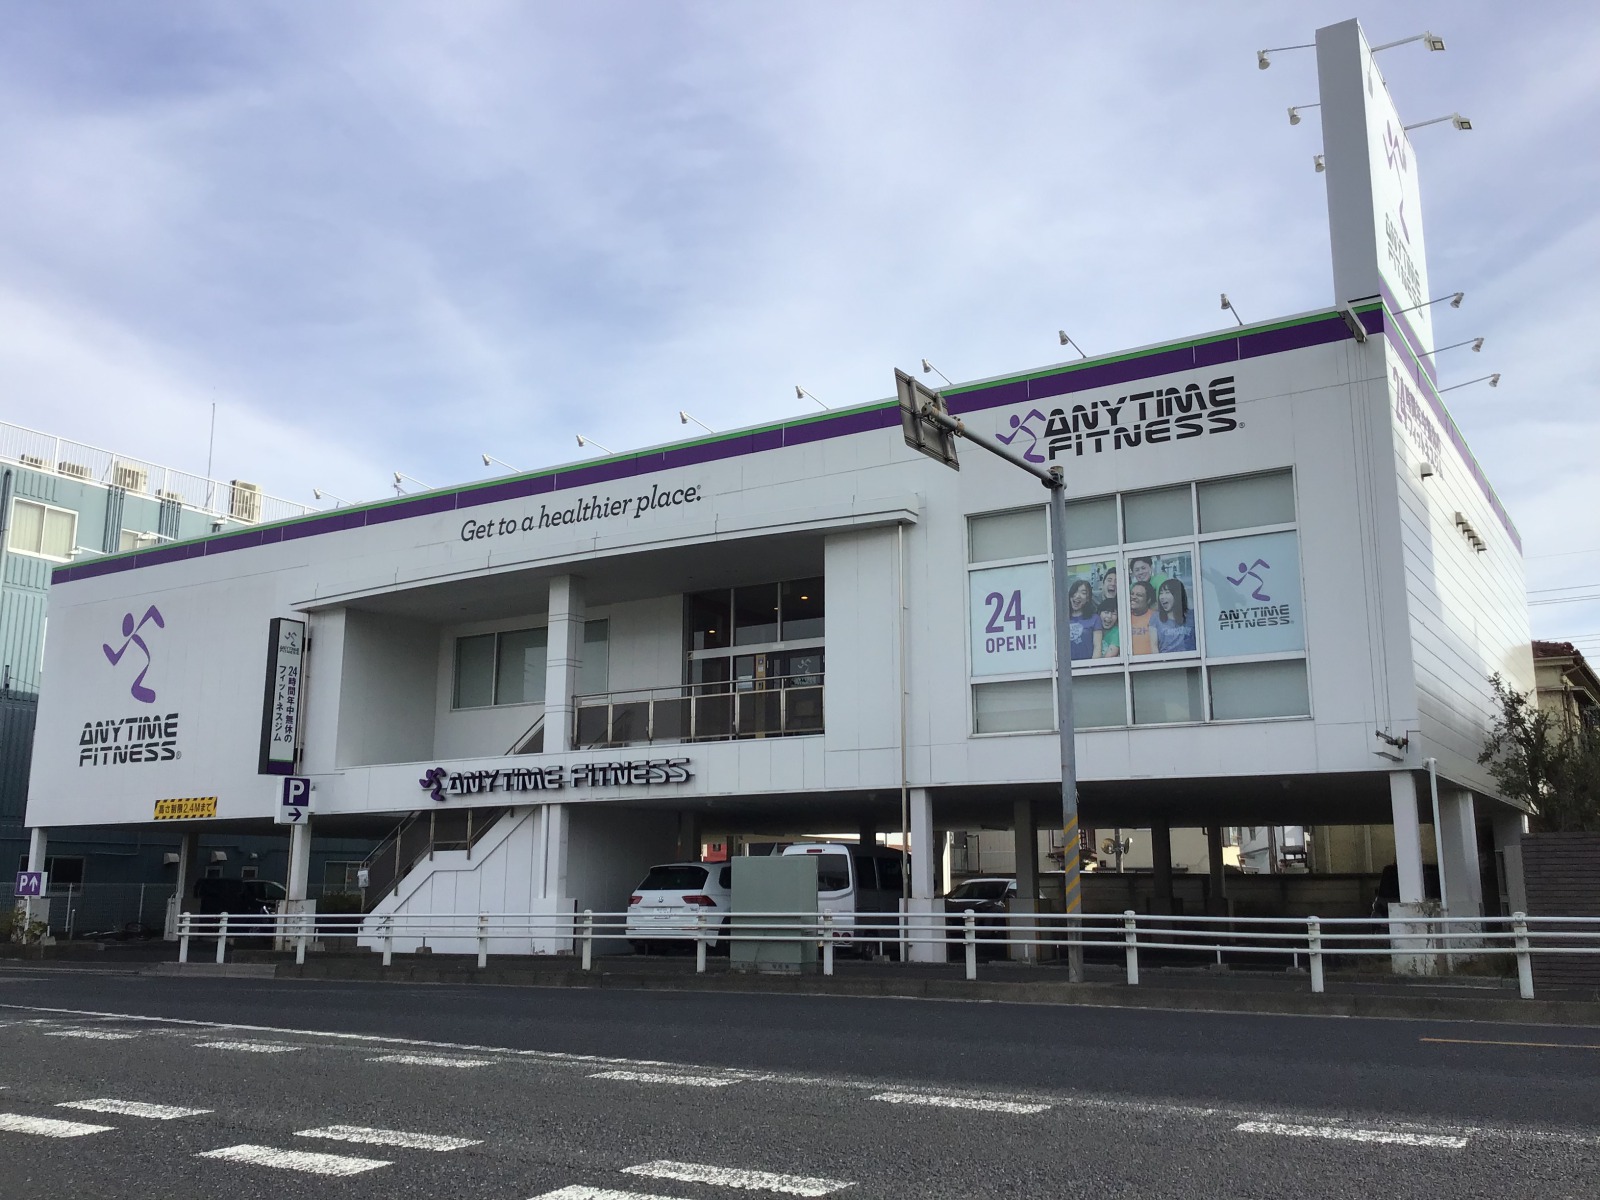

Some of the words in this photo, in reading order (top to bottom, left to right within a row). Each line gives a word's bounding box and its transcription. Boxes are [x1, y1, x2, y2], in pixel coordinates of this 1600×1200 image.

[1044, 376, 1236, 438] ANYTIME
[1048, 407, 1237, 461] FITNESS
[461, 519, 495, 541] Get
[498, 518, 517, 536] to
[521, 516, 534, 531] a
[537, 495, 632, 530] healthier
[1218, 604, 1290, 621] ANYTIME
[1220, 615, 1290, 630] FITNESS
[985, 633, 1037, 654] OPEN!!
[273, 665, 287, 742] フィットネスジム
[284, 665, 298, 743] 24時間年中無休の
[79, 713, 179, 746] ANYTIME
[79, 740, 177, 767] FITNESS
[288, 780, 305, 804] P
[446, 765, 564, 794] ANYTIME
[570, 758, 691, 788] FITNESS
[19, 874, 29, 892] P
